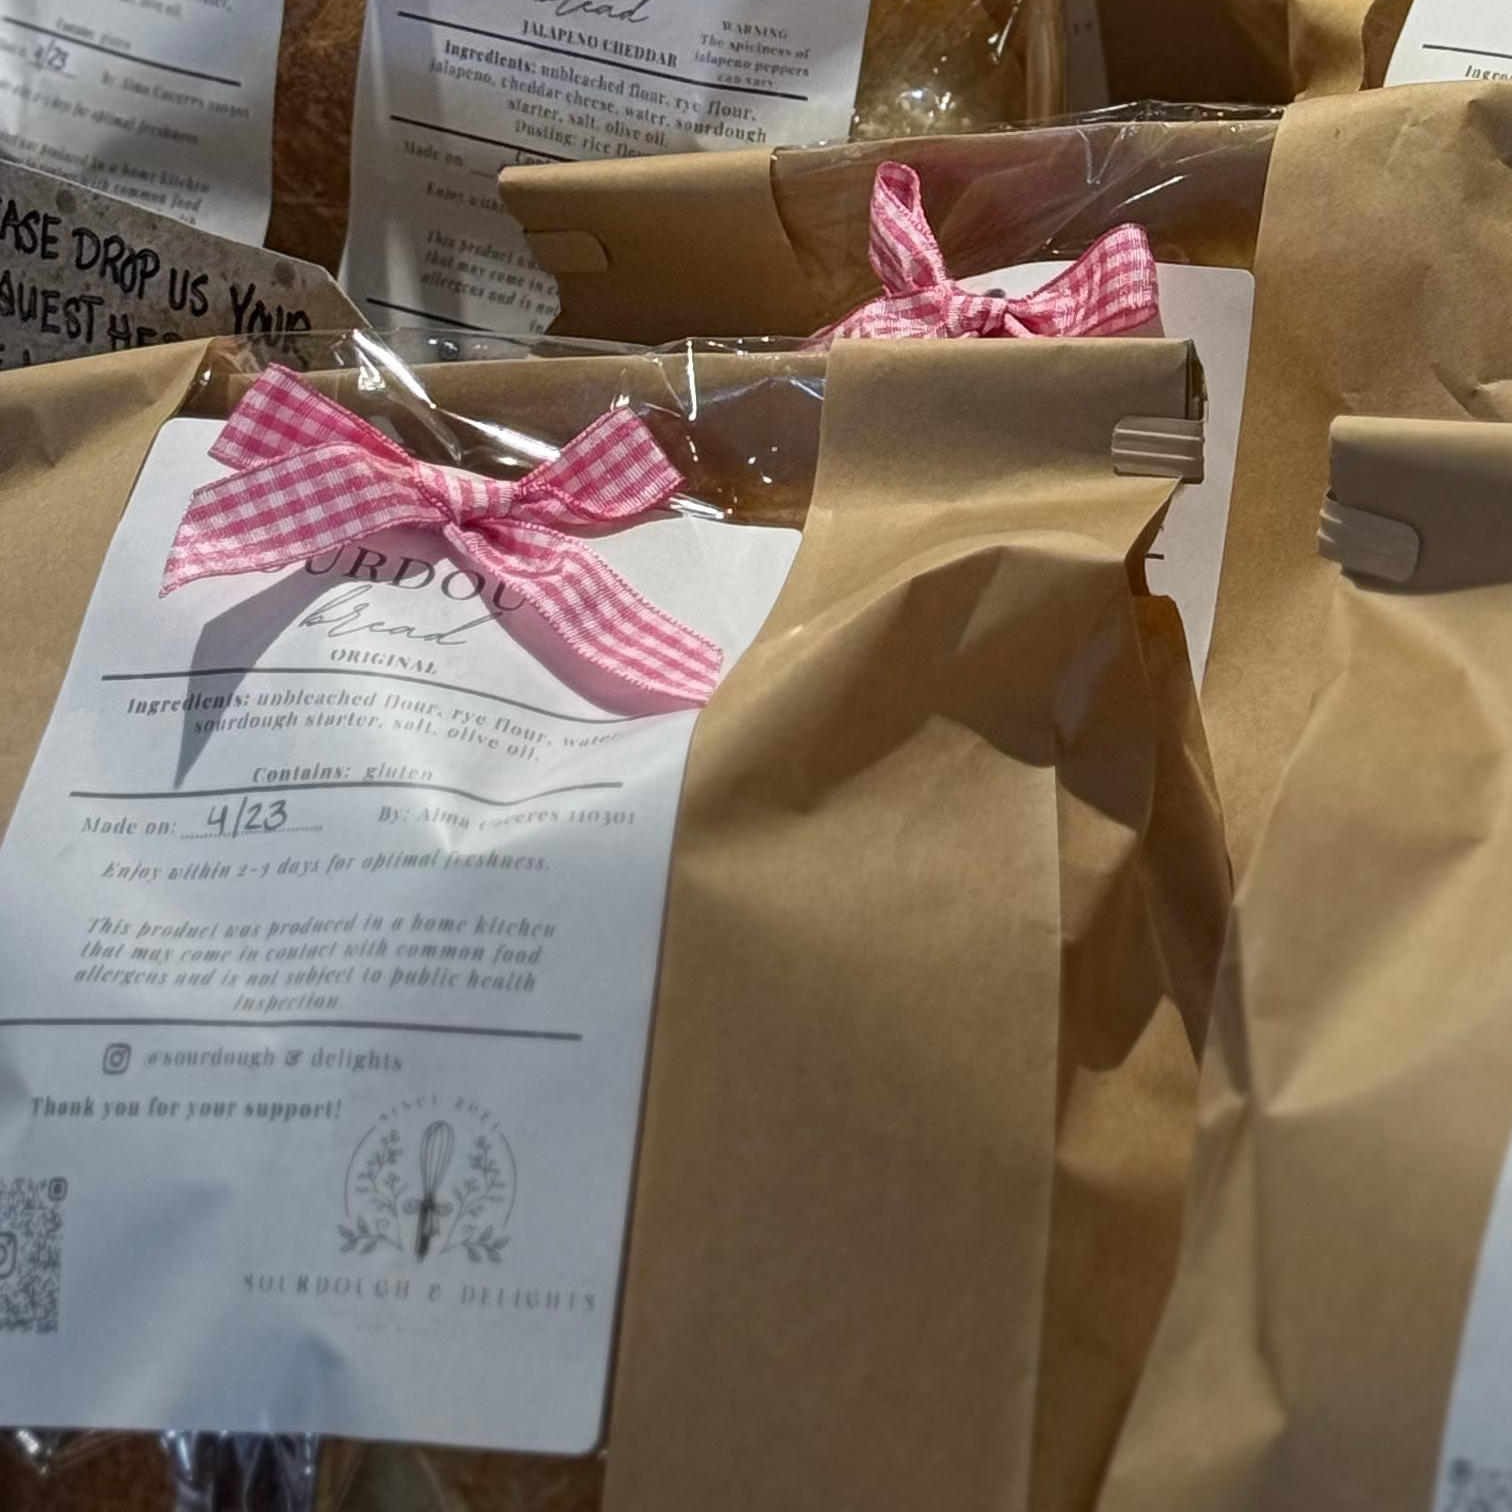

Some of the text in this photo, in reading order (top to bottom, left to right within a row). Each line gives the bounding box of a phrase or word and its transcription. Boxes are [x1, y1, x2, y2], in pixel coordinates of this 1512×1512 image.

[72, 226, 160, 299] DROP
[168, 268, 209, 317] US
[303, 541, 528, 613] URDOU
[298, 584, 503, 646] bread
[329, 648, 438, 675] ORIGINAL
[256, 688, 378, 714] unbleached
[450, 707, 487, 729] rye
[192, 709, 298, 734] sourdough
[445, 720, 499, 750] olive
[363, 761, 432, 785] gluten
[80, 815, 138, 835] Made
[205, 797, 289, 839] 4/23
[567, 809, 635, 826] 110301
[99, 860, 162, 884] Enjoy
[166, 859, 231, 881] within
[275, 855, 320, 878] days
[323, 852, 356, 875] for
[360, 850, 440, 873] optimal
[86, 911, 557, 941] This product was produced in a home kitchen
[78, 937, 543, 966] that may come in contact with common food
[283, 1048, 304, 1067] &
[309, 1046, 402, 1072] delights
[30, 1093, 342, 1123] Thank you for your support!
[242, 1272, 595, 1312] SOURDOUGH & DELIGHTS
